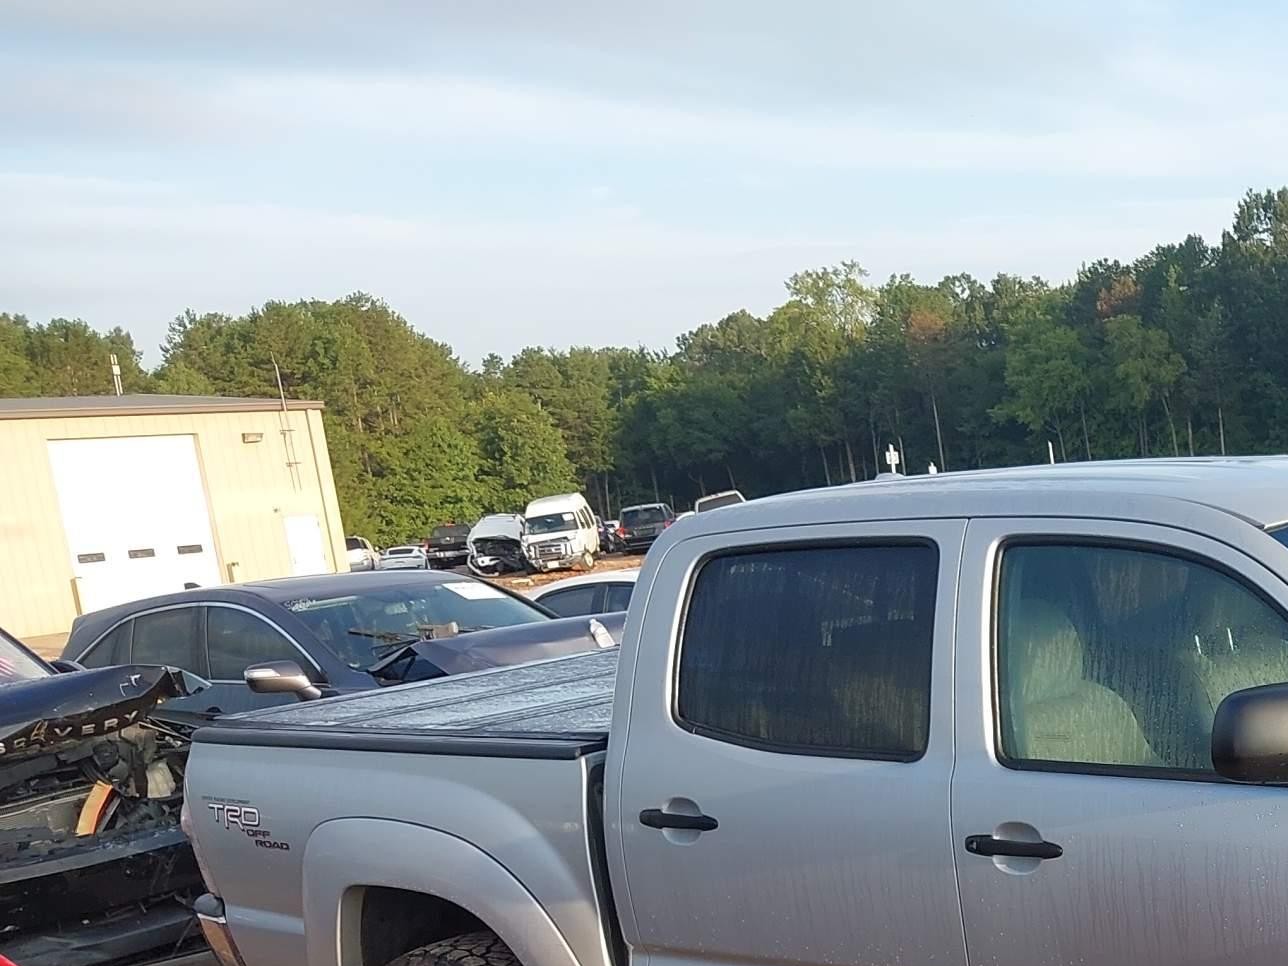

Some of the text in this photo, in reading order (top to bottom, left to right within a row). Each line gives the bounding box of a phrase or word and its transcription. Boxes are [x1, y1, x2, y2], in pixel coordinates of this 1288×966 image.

[207, 803, 261, 831] TRD
[246, 829, 271, 838] OFF
[255, 840, 290, 850] ROAD
